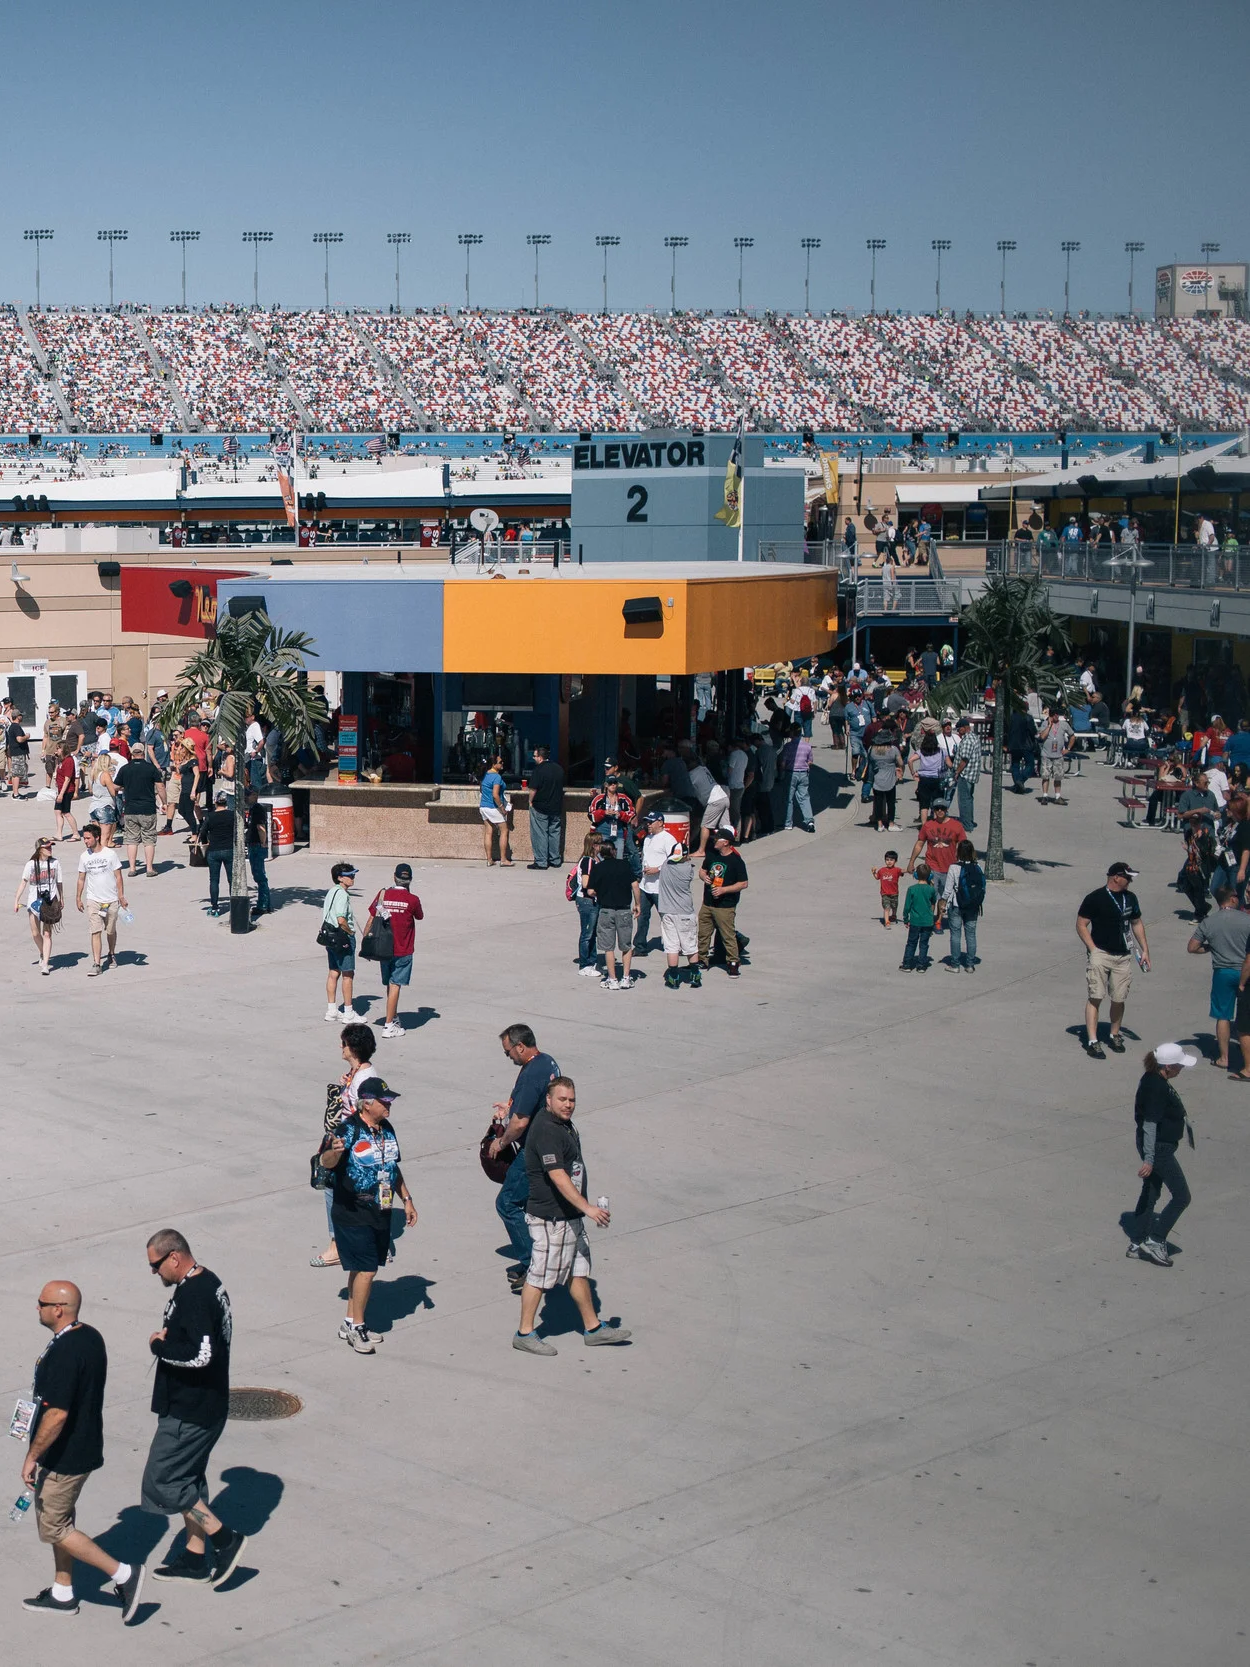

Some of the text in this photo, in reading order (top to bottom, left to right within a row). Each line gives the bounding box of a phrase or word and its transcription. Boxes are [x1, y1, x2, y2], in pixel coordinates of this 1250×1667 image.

[574, 440, 705, 469] ELEVATOR
[821, 457, 833, 491] DRINKS
[626, 485, 649, 523] 2
[195, 585, 217, 624] Neo
